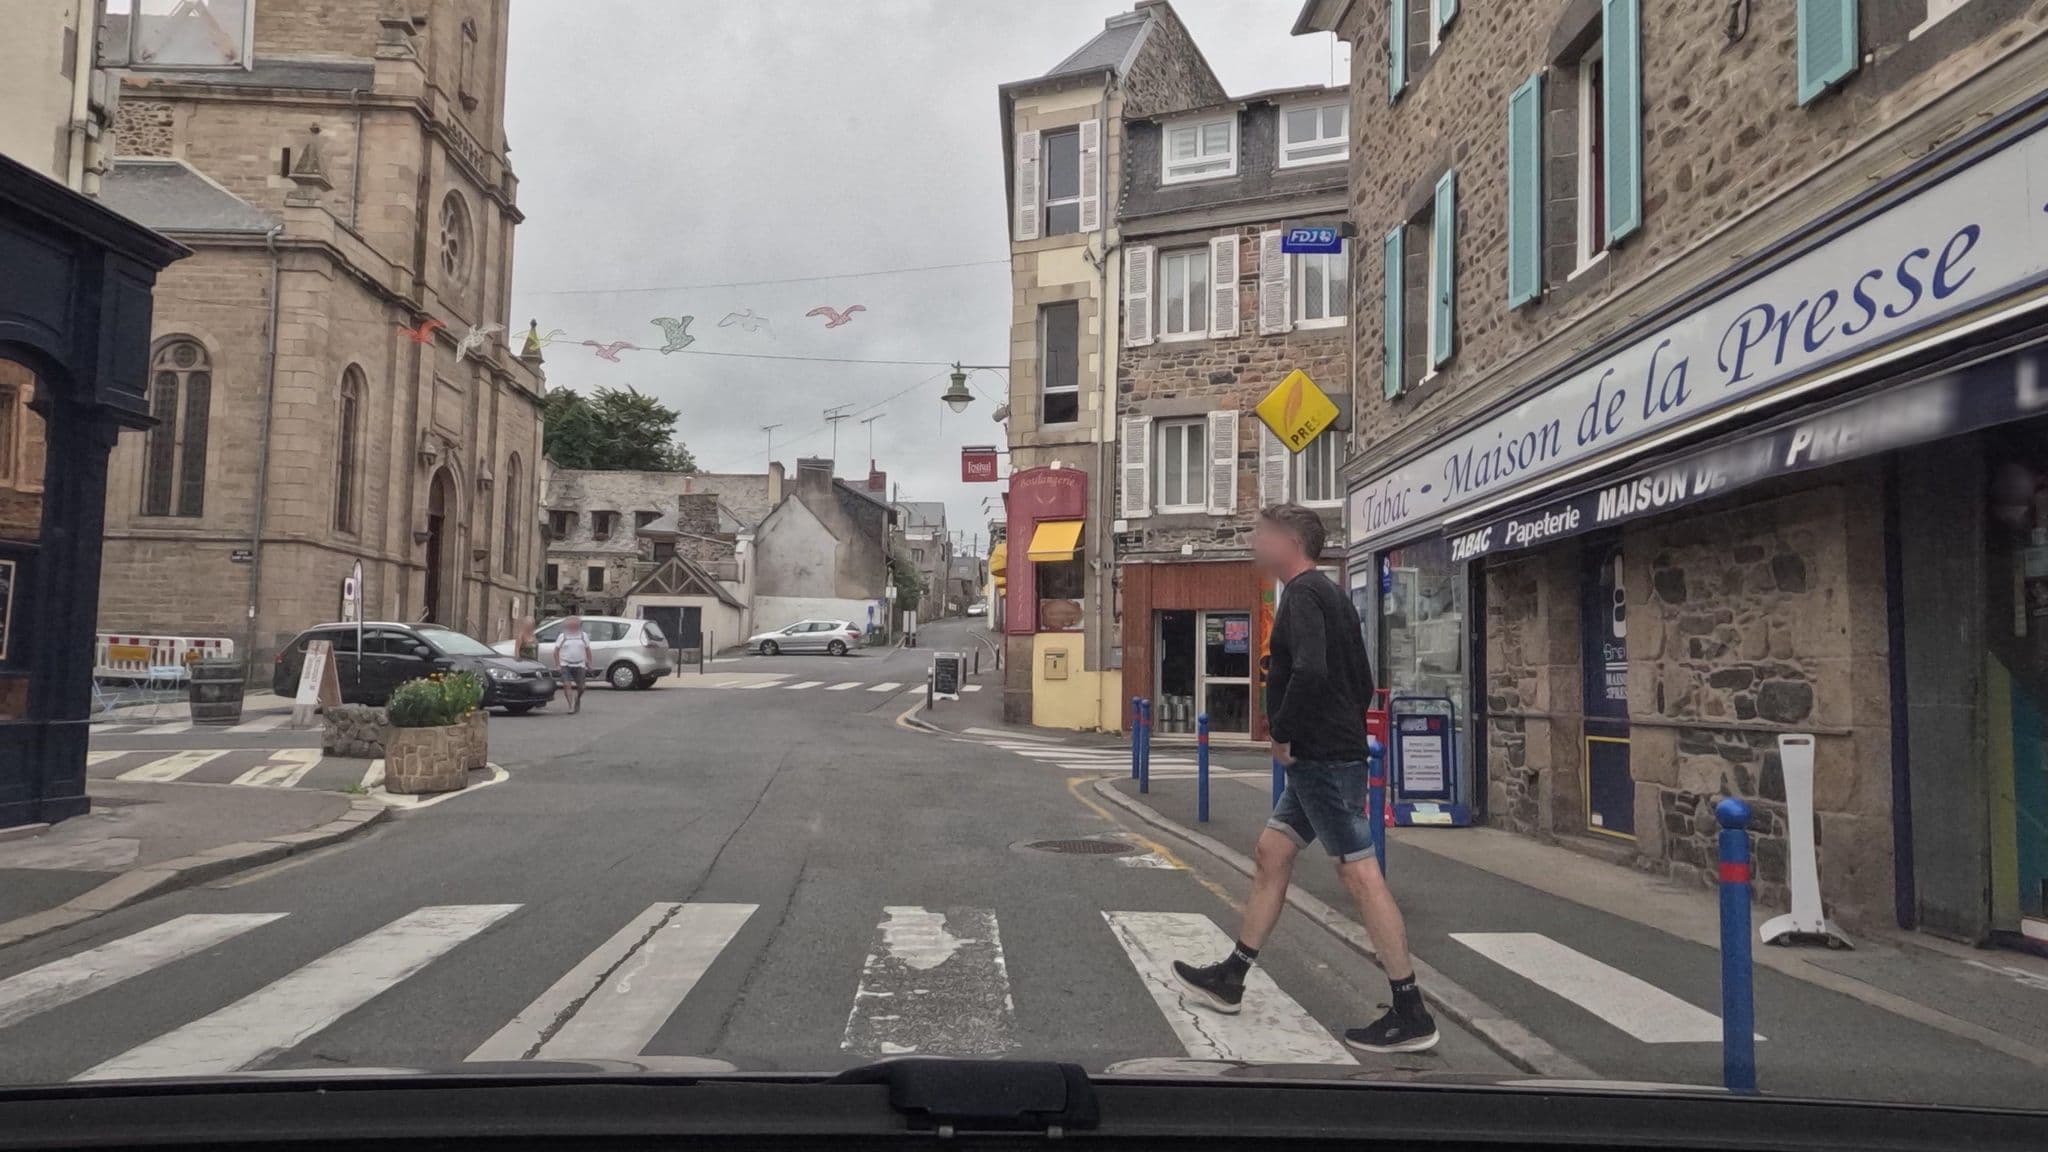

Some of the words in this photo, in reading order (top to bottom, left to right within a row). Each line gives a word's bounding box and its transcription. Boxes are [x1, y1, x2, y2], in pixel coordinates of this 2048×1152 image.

[1290, 229, 1319, 243] FDJ
[1362, 479, 1412, 534] Tabac
[1443, 420, 1562, 502] Maison
[1577, 368, 1626, 446] de
[1643, 338, 1692, 420] la
[1717, 223, 1981, 387] Presse
[1451, 526, 1491, 562] TABAC
[1505, 504, 1580, 548] Papeterie
[1597, 465, 1690, 522] MAISON
